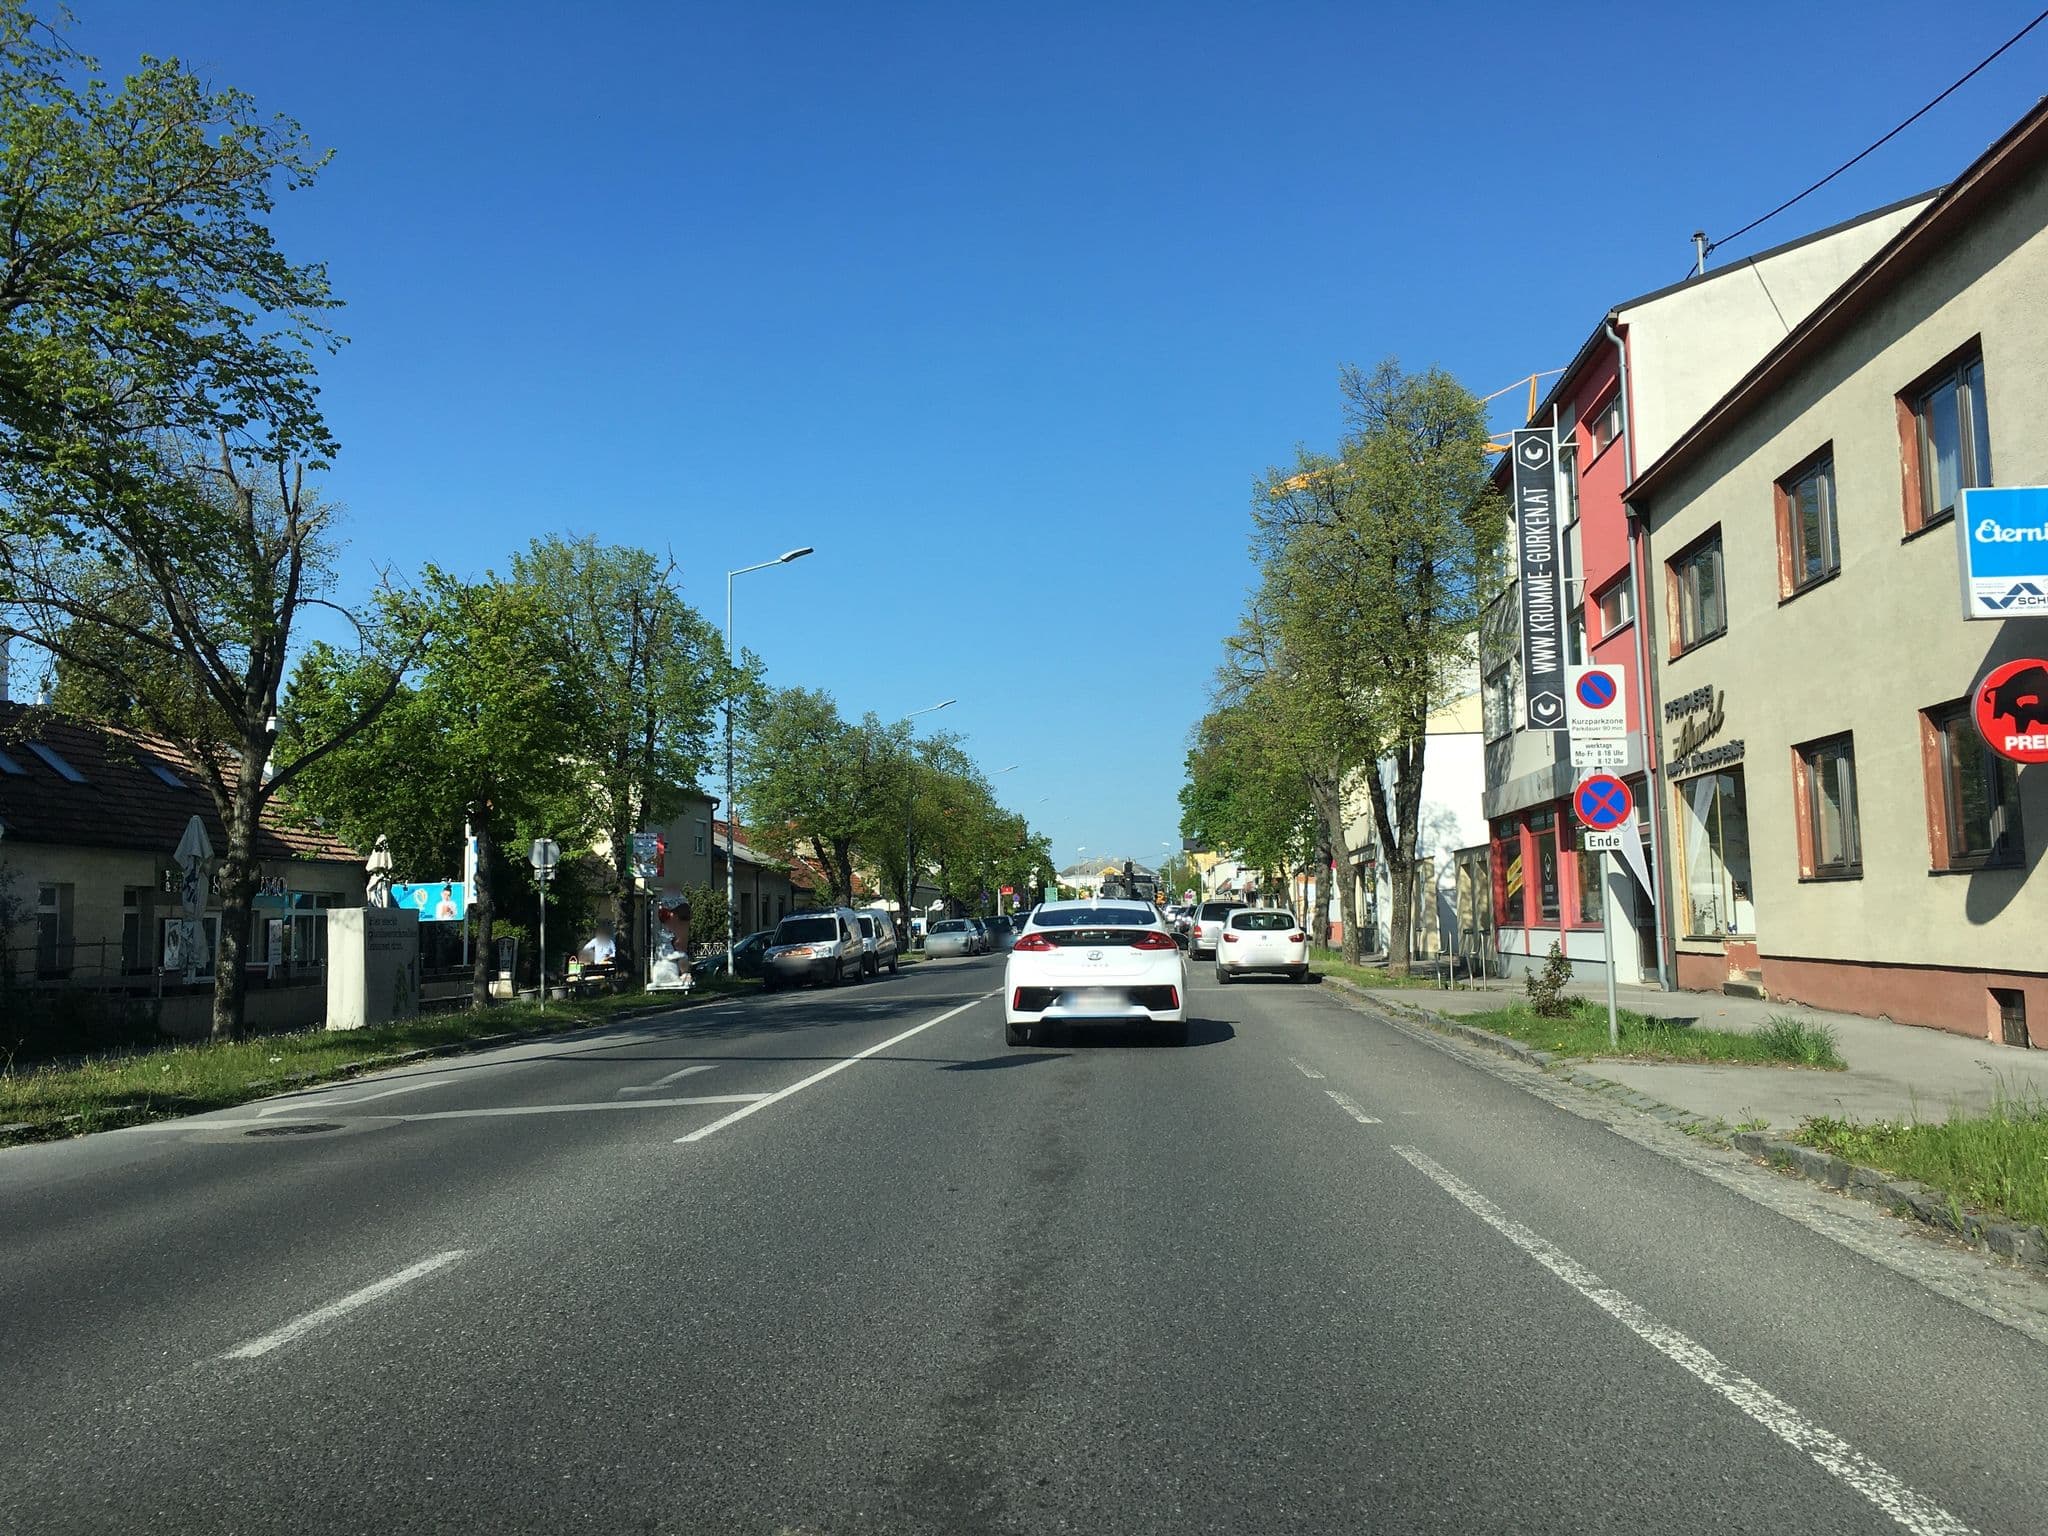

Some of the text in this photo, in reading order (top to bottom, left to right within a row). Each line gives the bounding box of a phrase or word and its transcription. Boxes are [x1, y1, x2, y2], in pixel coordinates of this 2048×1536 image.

[1523, 486, 1557, 675] WWW.KRUMME-GURKEN.AT
[2018, 596, 2048, 605] SCH
[1585, 741, 1612, 749] werktags
[2005, 734, 2048, 751] PRE
[1589, 835, 1620, 847] Ende
